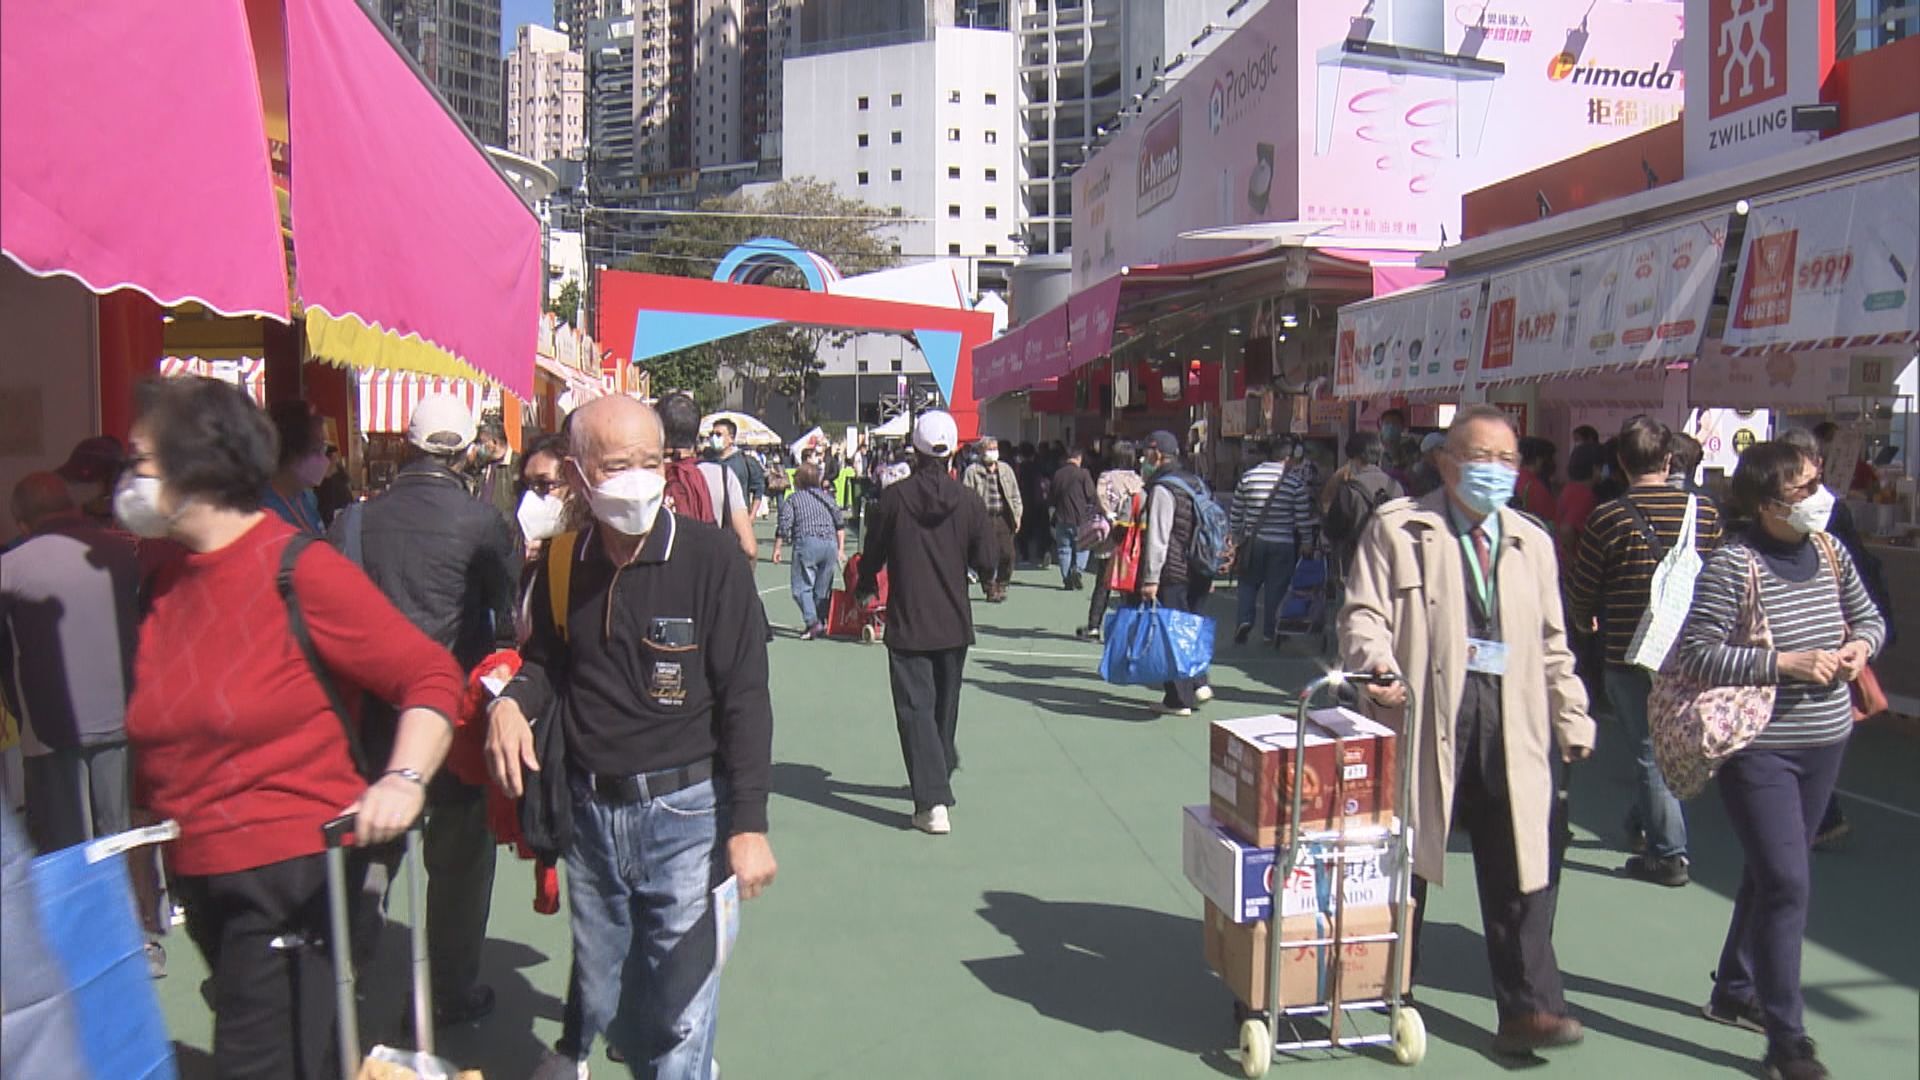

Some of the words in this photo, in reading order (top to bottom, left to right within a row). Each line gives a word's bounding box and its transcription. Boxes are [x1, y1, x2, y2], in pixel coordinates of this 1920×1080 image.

[1226, 41, 1278, 108] Prologic
[1547, 51, 1674, 89] Primada
[1708, 108, 1788, 150] ZWILLING
